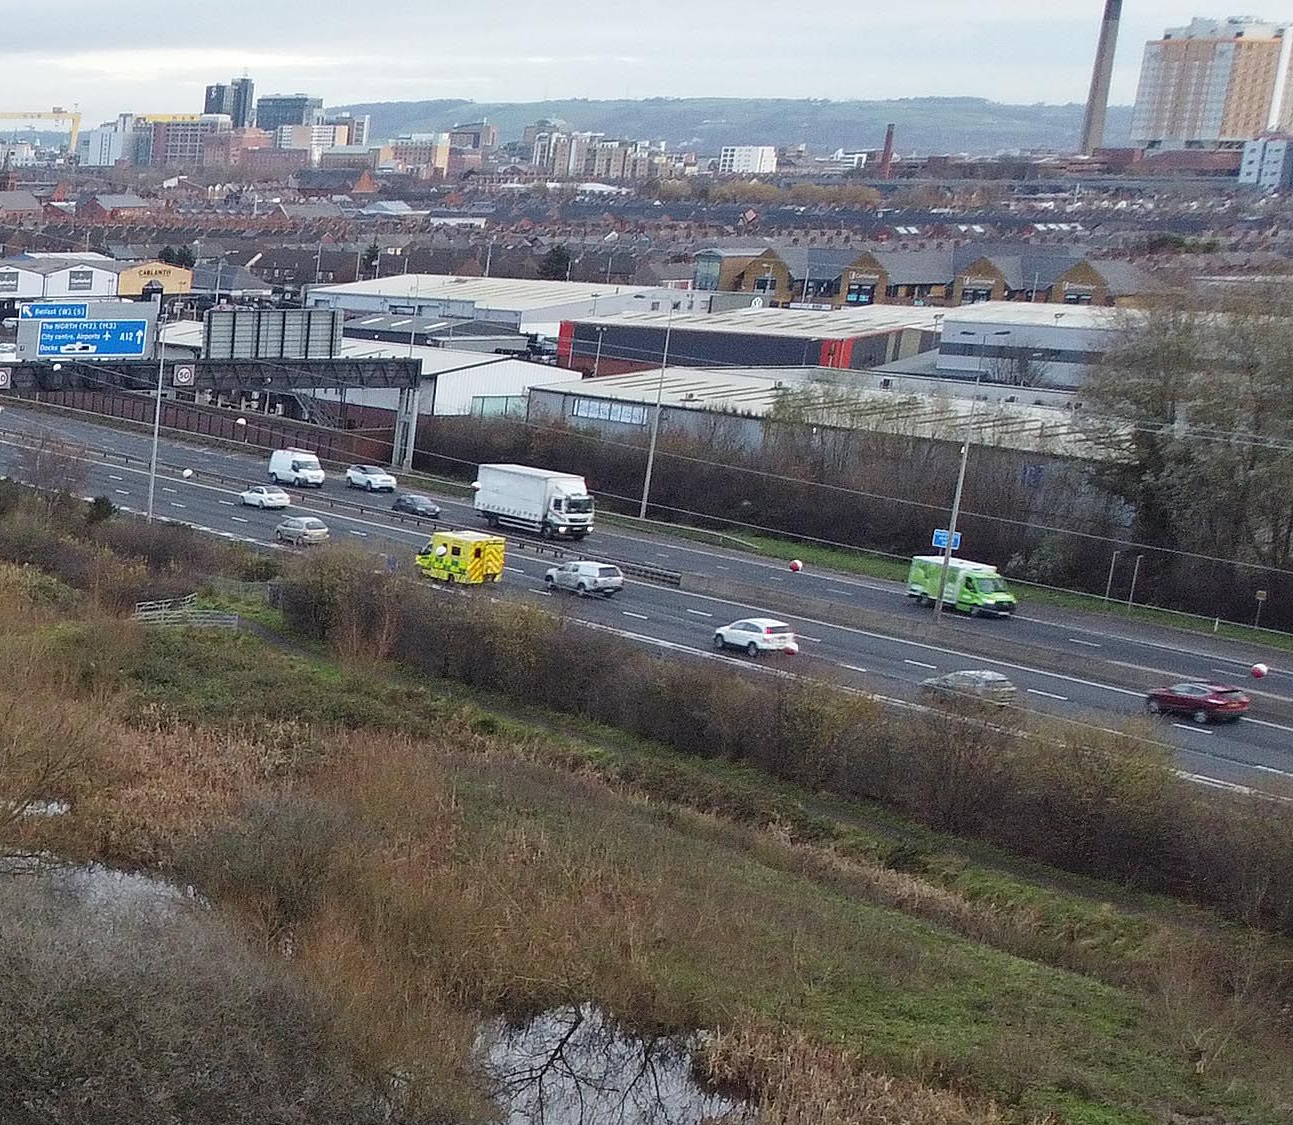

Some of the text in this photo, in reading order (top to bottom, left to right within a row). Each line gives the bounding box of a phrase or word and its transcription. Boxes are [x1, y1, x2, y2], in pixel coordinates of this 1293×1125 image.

[54, 322, 78, 330] NORTH
[41, 333, 54, 341] City
[119, 332, 134, 341] A12
